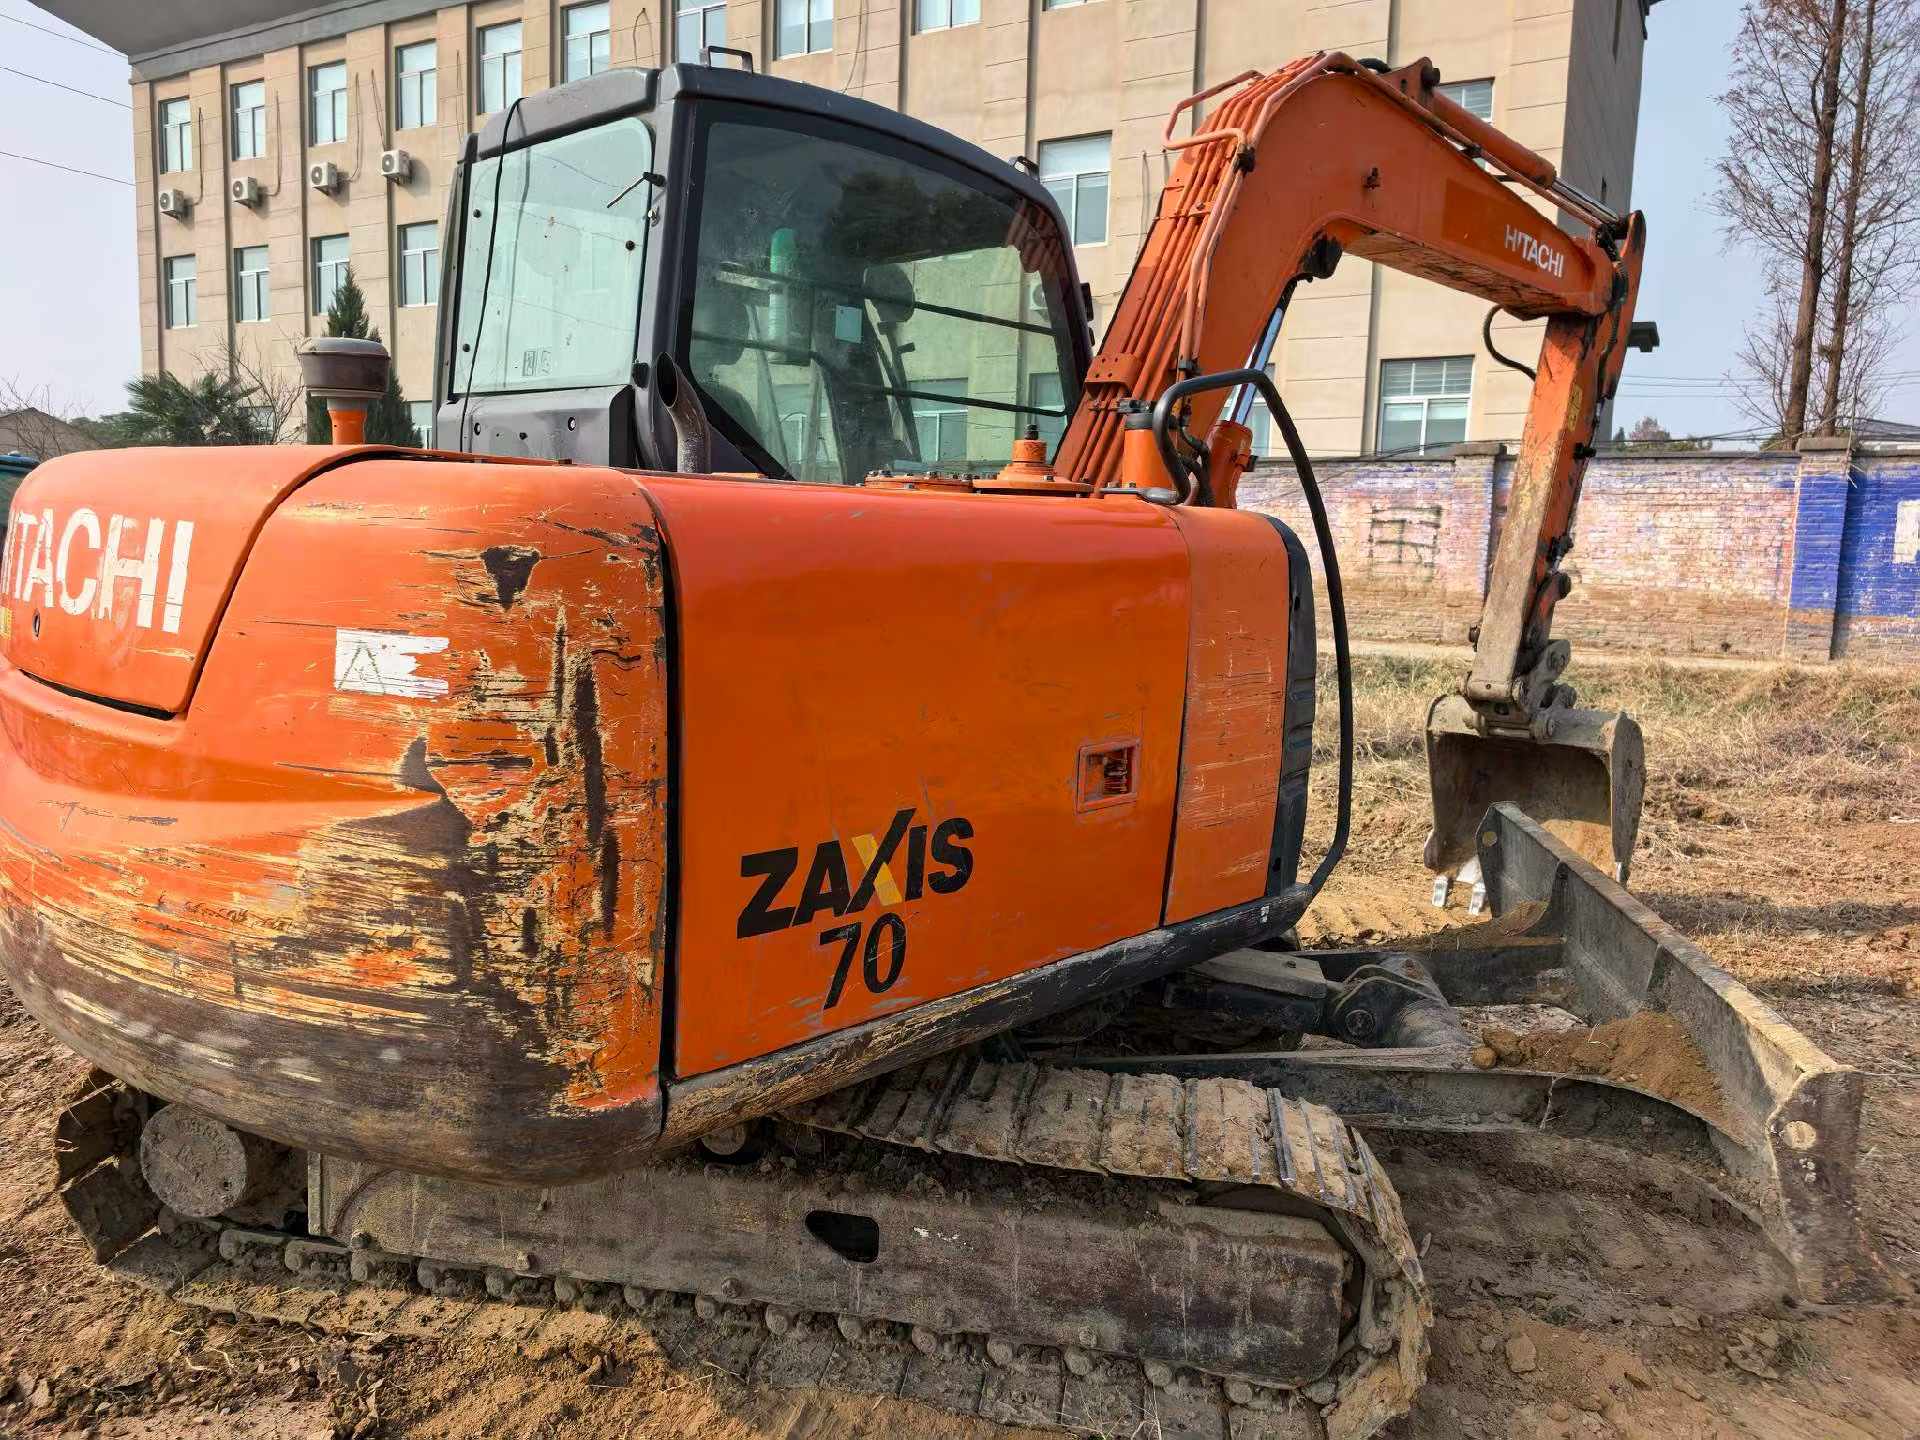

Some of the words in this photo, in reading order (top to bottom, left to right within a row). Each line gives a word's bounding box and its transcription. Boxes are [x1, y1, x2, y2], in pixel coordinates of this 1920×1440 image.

[1, 507, 195, 635] ITACHI
[736, 808, 975, 939] ZAXIS
[819, 912, 907, 1010] 70
